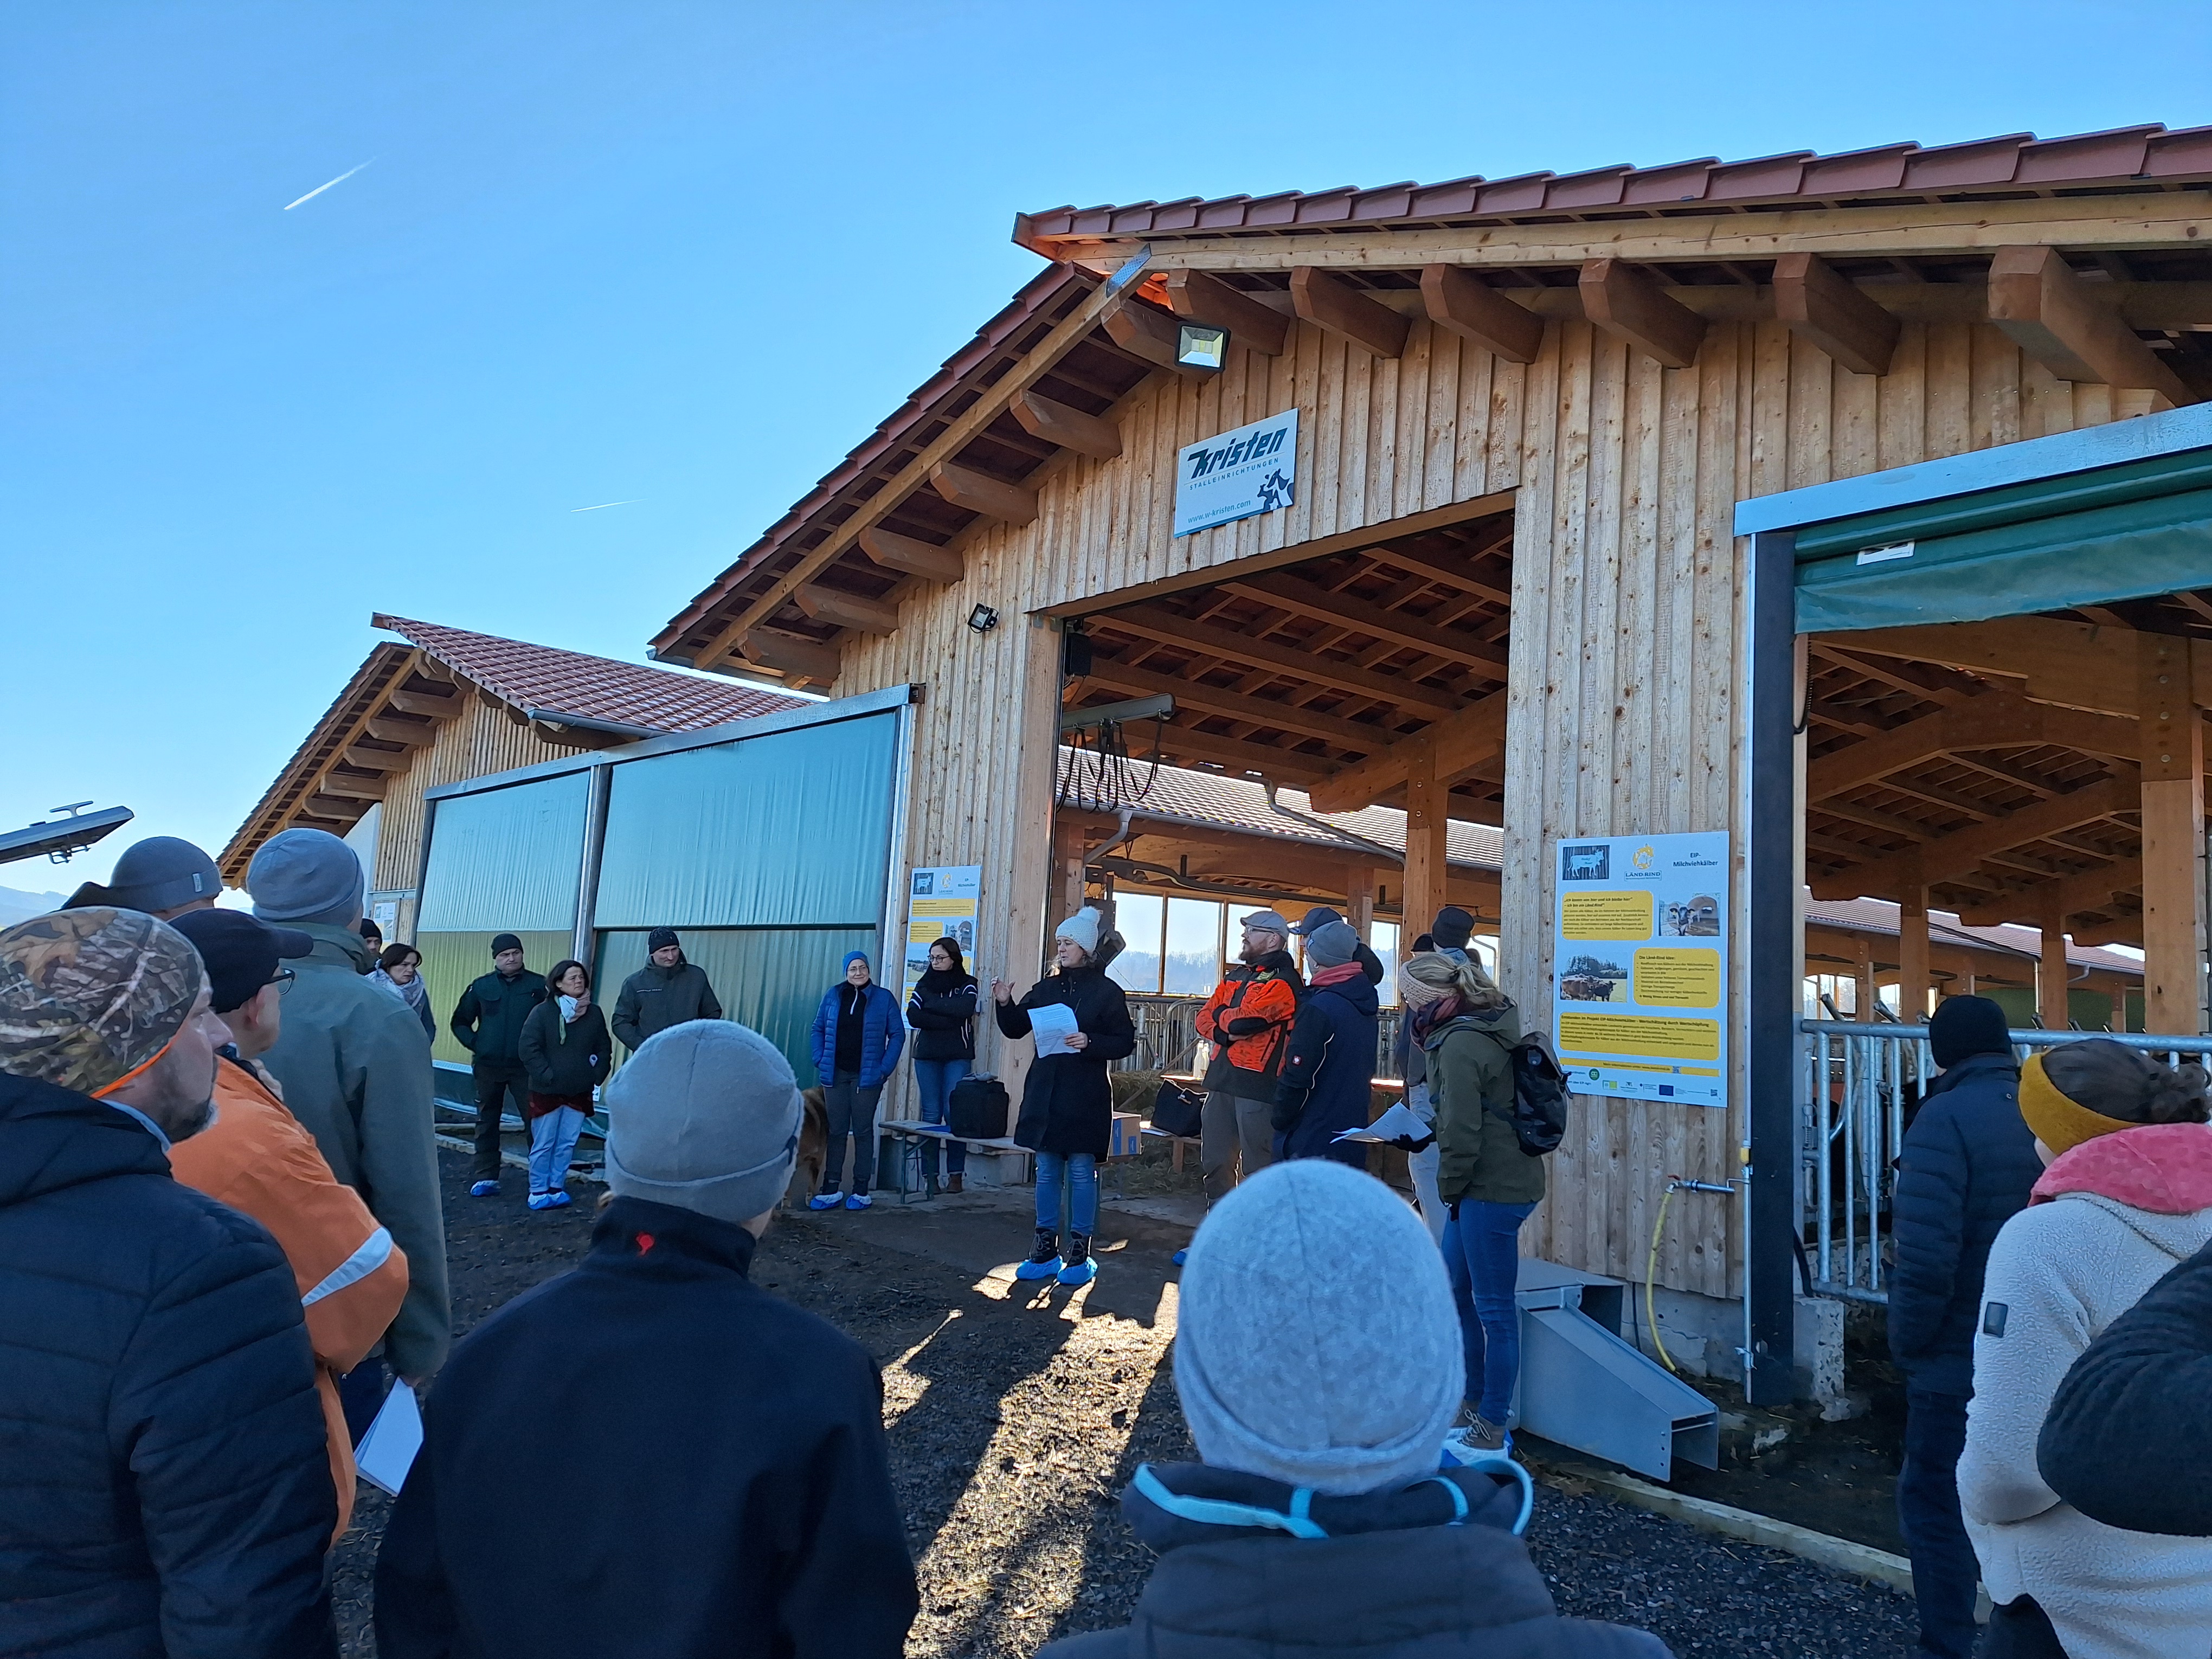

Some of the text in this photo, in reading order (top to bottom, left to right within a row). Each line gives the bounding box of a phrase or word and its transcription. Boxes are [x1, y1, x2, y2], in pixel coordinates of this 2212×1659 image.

[1187, 427, 1288, 479] Kristen
[1189, 457, 1279, 491] STALLEINRICHTUNGEN
[1187, 499, 1251, 524] www.w-kristen.com
